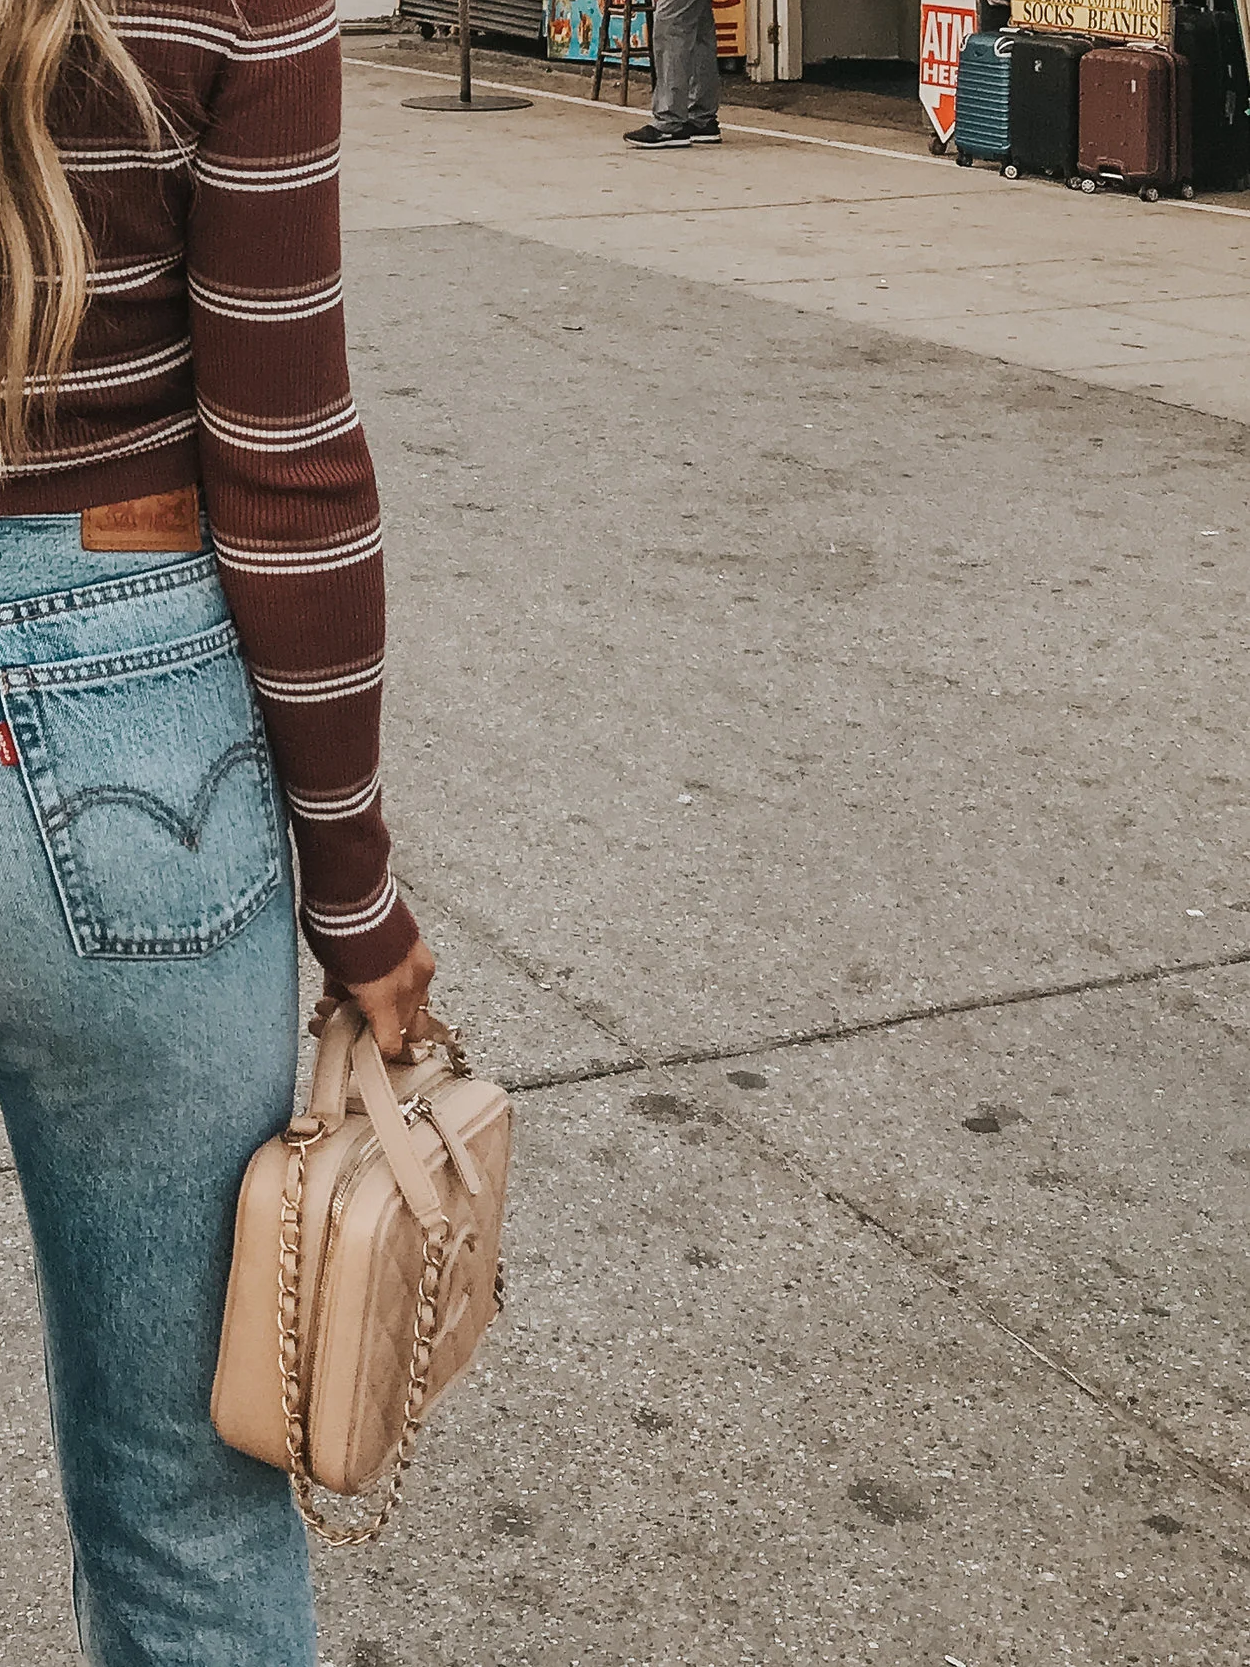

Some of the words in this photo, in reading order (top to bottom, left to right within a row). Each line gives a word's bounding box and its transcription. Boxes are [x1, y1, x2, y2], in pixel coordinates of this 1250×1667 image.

[923, 10, 975, 63] ATM
[1023, 2, 1075, 27] SOCKS
[1088, 8, 1158, 38] BEANIES
